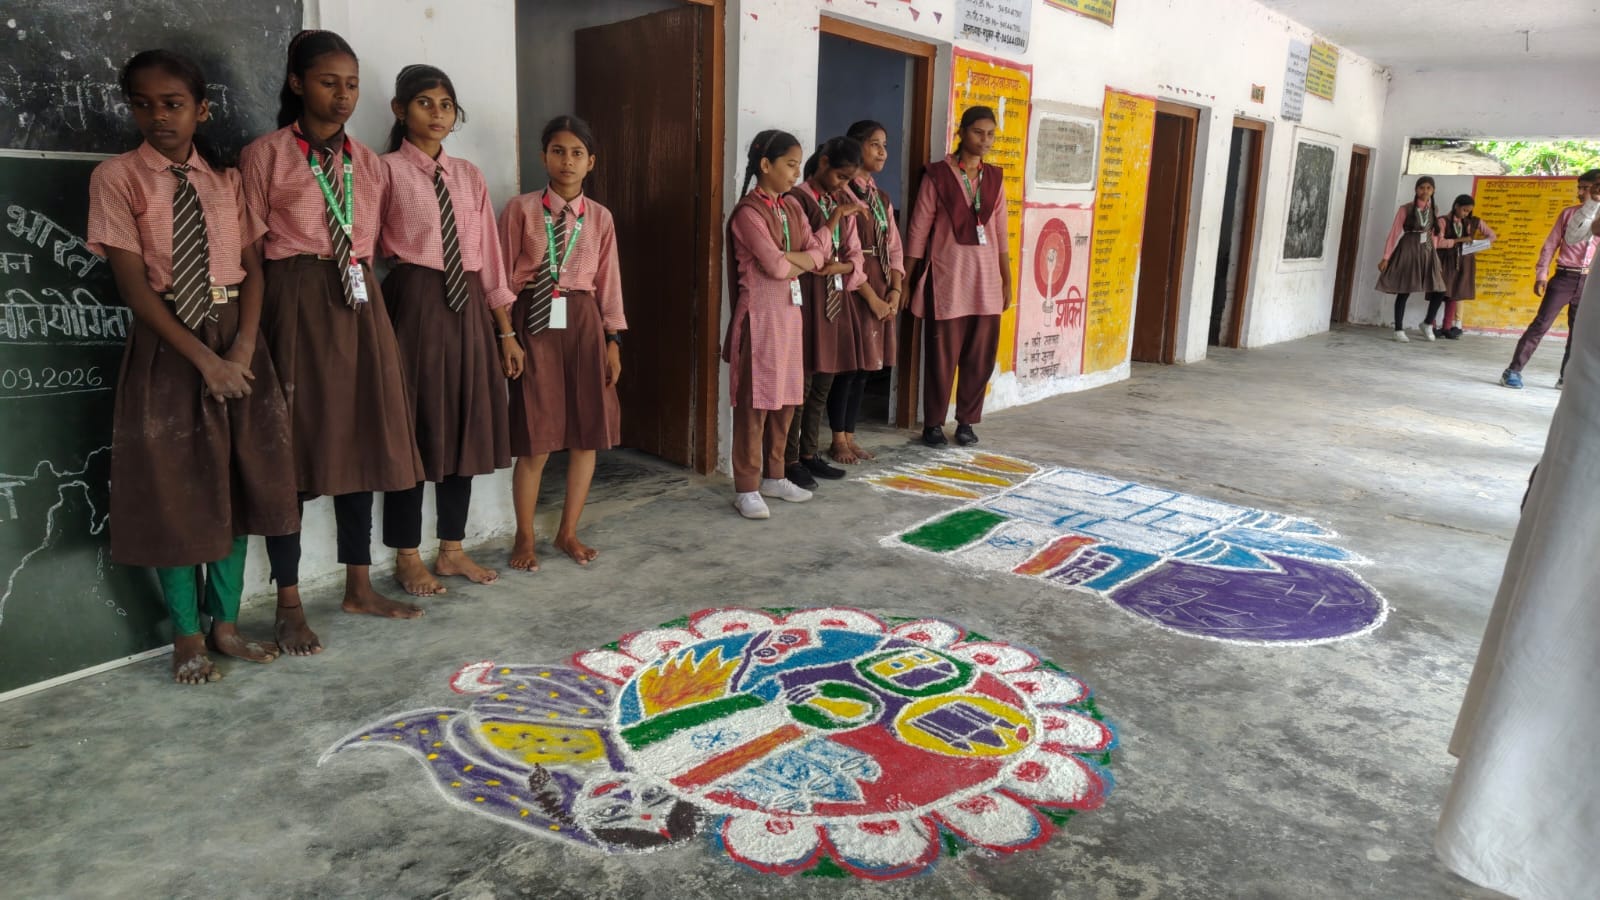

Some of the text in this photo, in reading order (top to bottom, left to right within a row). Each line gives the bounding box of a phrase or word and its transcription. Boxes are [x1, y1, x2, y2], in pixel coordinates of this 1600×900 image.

[7, 204, 107, 278] भारत
[1055, 285, 1085, 329] शक्ति
[2, 367, 103, 390] 09.2026
